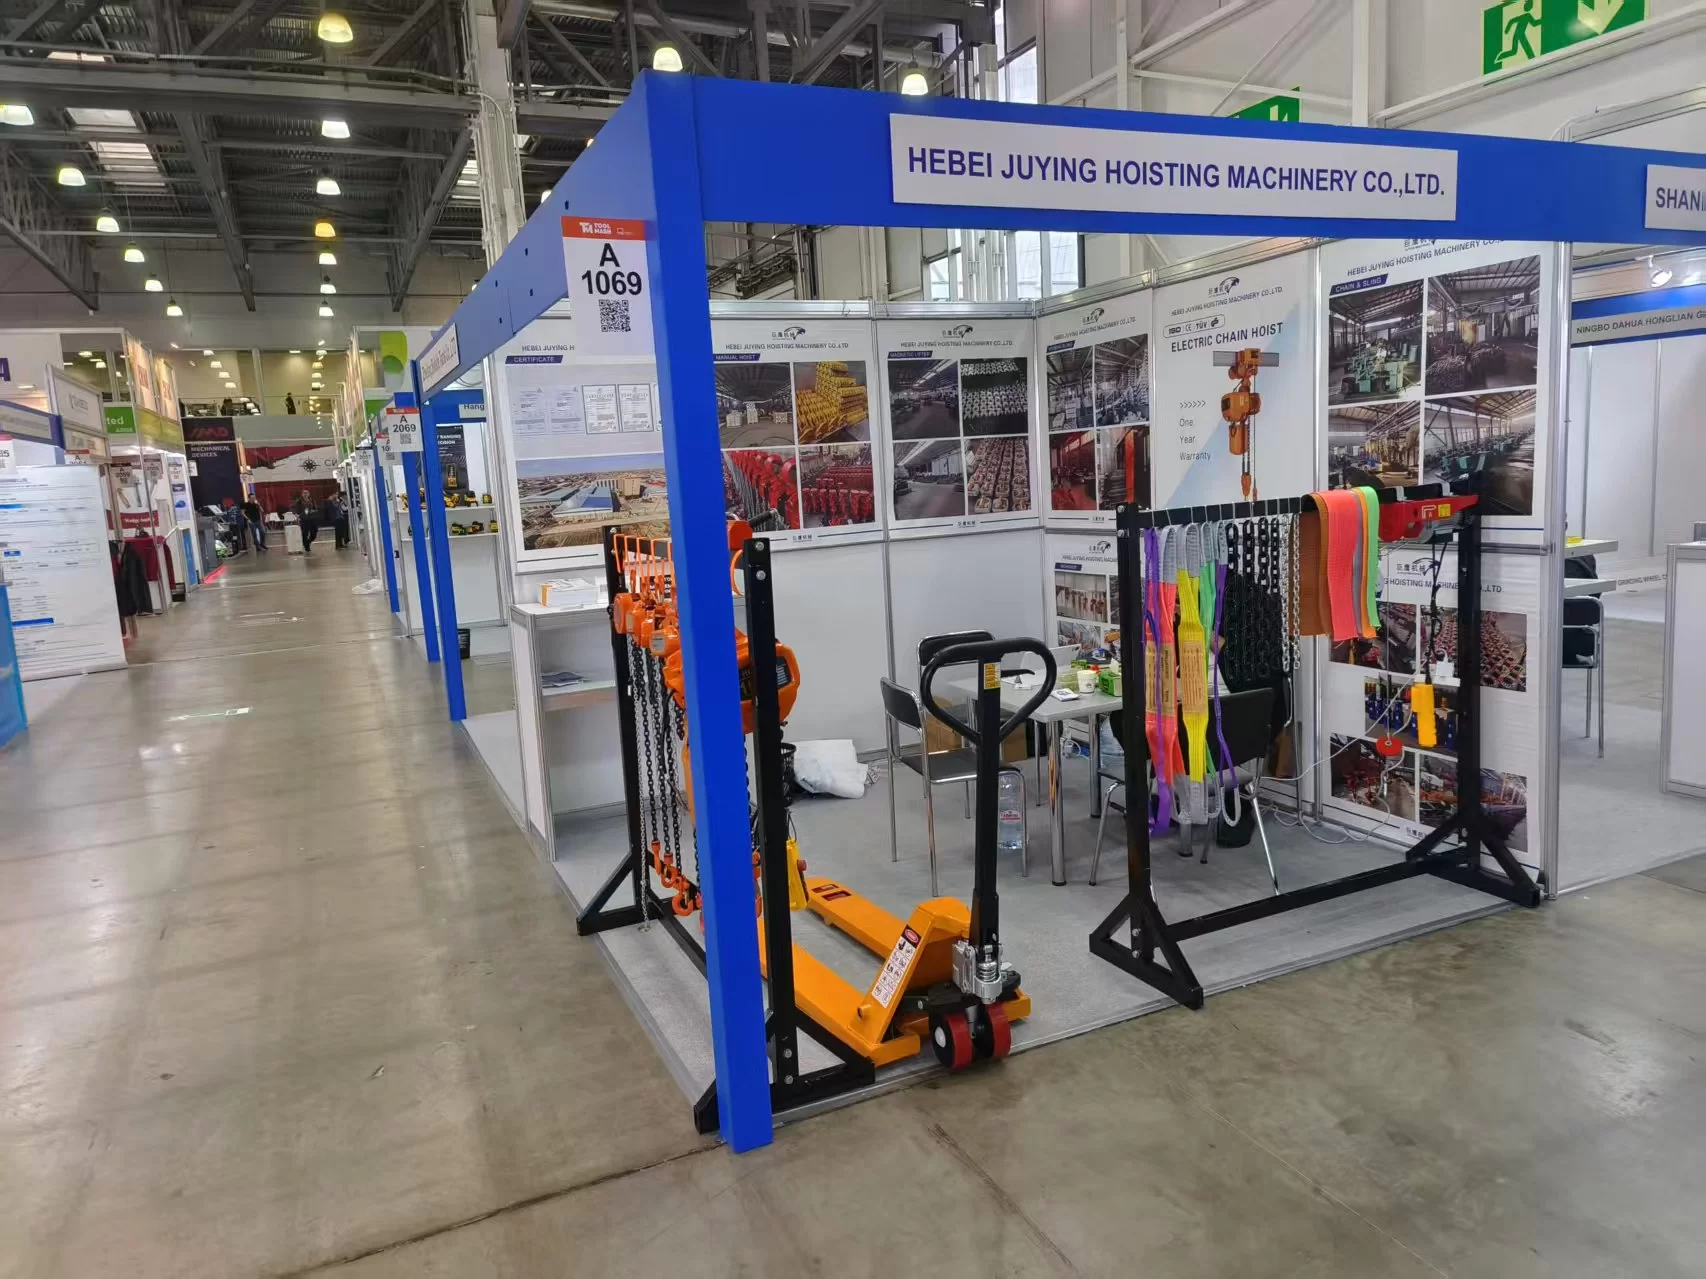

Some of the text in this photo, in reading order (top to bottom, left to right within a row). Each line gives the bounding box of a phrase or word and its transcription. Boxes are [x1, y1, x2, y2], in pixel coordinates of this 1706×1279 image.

[908, 146, 1446, 198] HEBEI JUYING HOISTING MACHINERY CO.,LTD.
[599, 242, 621, 267] A
[1347, 266, 1368, 277] HEBEI
[1368, 259, 1395, 272] JUYING
[1396, 251, 1432, 266] HOISTING
[1434, 240, 1483, 257] MACHINERY
[581, 270, 642, 295] 1069
[1362, 277, 1382, 288] SLING
[1576, 323, 1610, 334] NINGBO
[1612, 319, 1643, 330] DAHUA
[1645, 312, 1694, 325] HONGLIAN
[1171, 322, 1284, 353] ELECTRIC CHAIN HOIST
[521, 344, 542, 352] HEBEI
[400, 415, 408, 424] A
[1179, 418, 1194, 427] One
[393, 424, 417, 433] 2069
[1180, 436, 1196, 444] Year
[1179, 452, 1211, 462] Warranty
[1390, 578, 1423, 588] HOISTING
